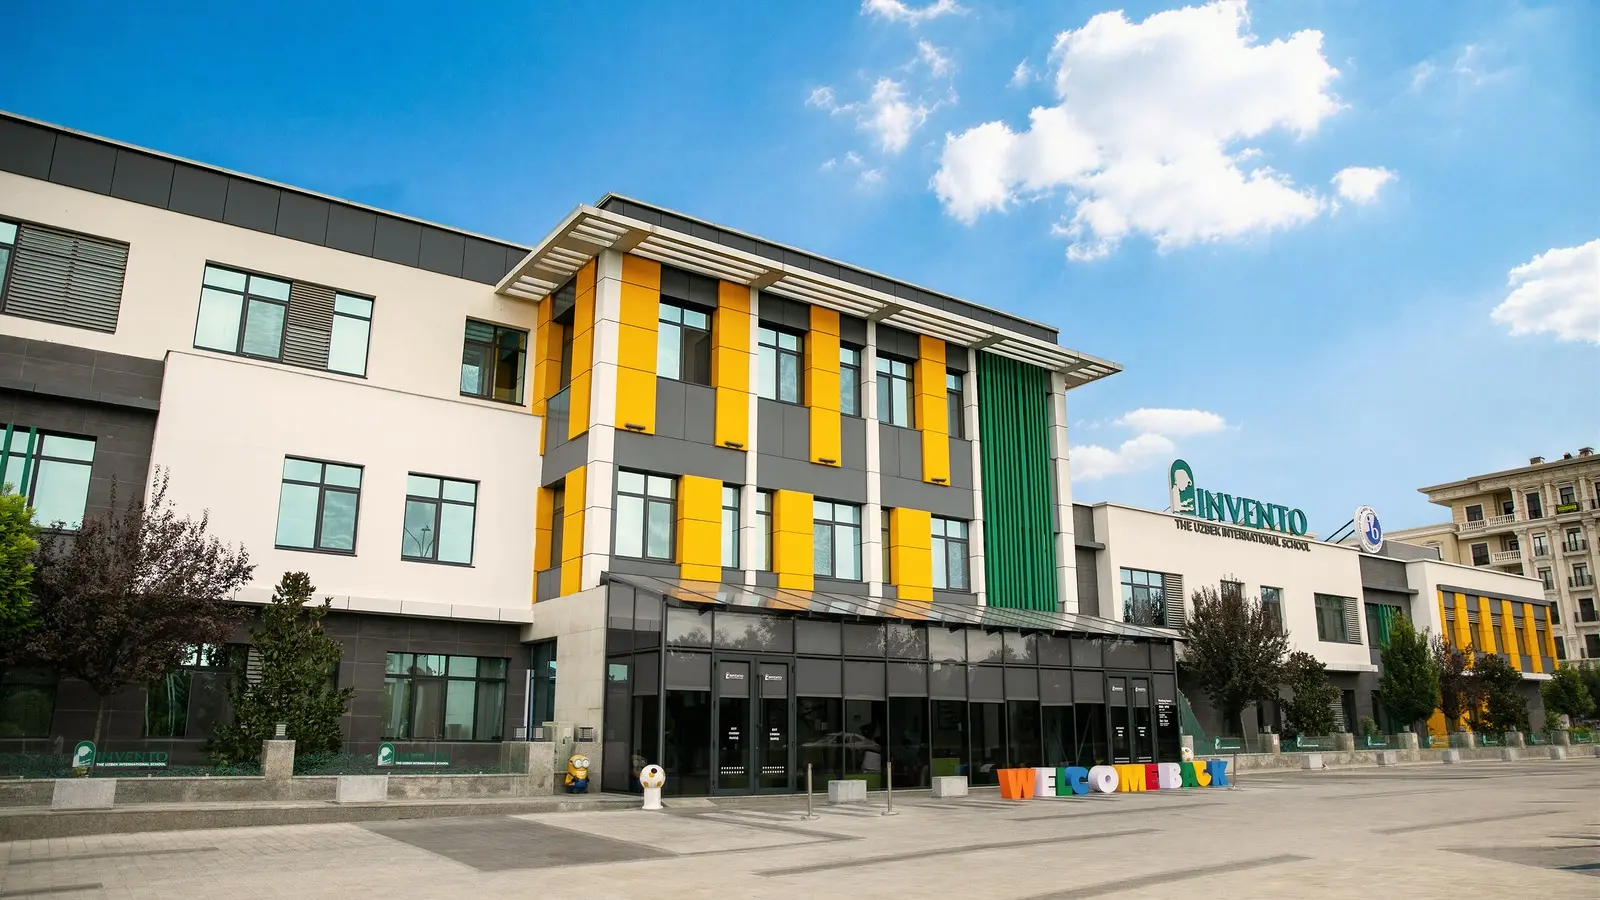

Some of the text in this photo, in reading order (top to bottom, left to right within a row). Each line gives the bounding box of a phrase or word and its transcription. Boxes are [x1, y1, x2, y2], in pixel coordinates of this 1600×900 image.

[1196, 487, 1308, 536] INVENTO
[1174, 518, 1311, 552] THE UZBEK INTERNATIONAL SCHOOL
[97, 751, 168, 762] INVENTO
